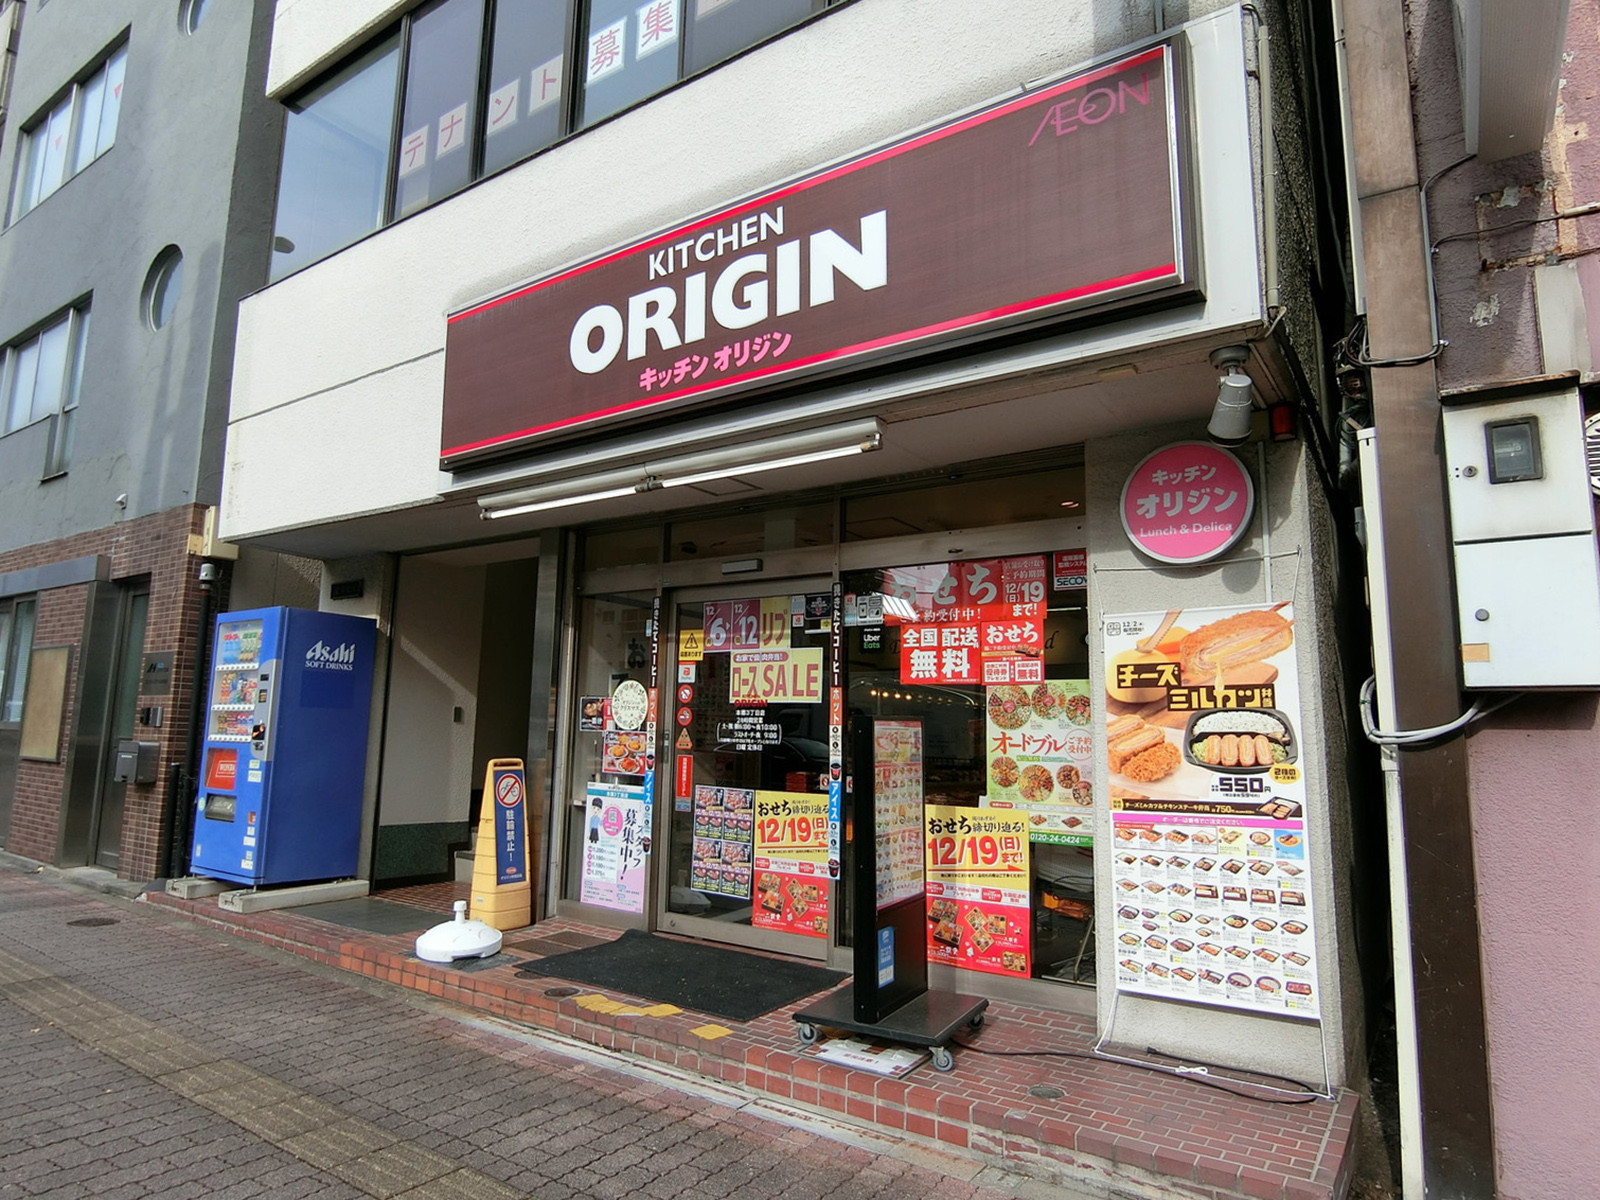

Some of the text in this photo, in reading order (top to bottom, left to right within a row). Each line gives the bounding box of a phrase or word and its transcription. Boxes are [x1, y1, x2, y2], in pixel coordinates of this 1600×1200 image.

[648, 205, 785, 281] KITCHEN
[569, 208, 889, 375] ORIGIN
[1151, 465, 1217, 486] キッチン
[1136, 487, 1239, 519] オリジン
[1139, 521, 1233, 538] Lunch & Delica
[1005, 580, 1044, 603] 12/19
[762, 609, 788, 646] リブ
[863, 634, 881, 642] Uber
[986, 621, 1039, 645] おせち
[306, 640, 356, 663] Asahi
[909, 648, 972, 679] 無料
[305, 660, 354, 671] SOFT DRINKS
[1118, 664, 1180, 687] チーズ
[762, 663, 819, 698] SALE
[990, 730, 1067, 756] オードブル
[758, 800, 792, 817] おせち
[830, 782, 840, 820] アイス
[757, 817, 812, 844] 12/19
[928, 815, 972, 835] おせち
[620, 808, 638, 881] 募集中!
[927, 835, 999, 866] 12/19
[1030, 833, 1080, 844] 0120-24-0424
